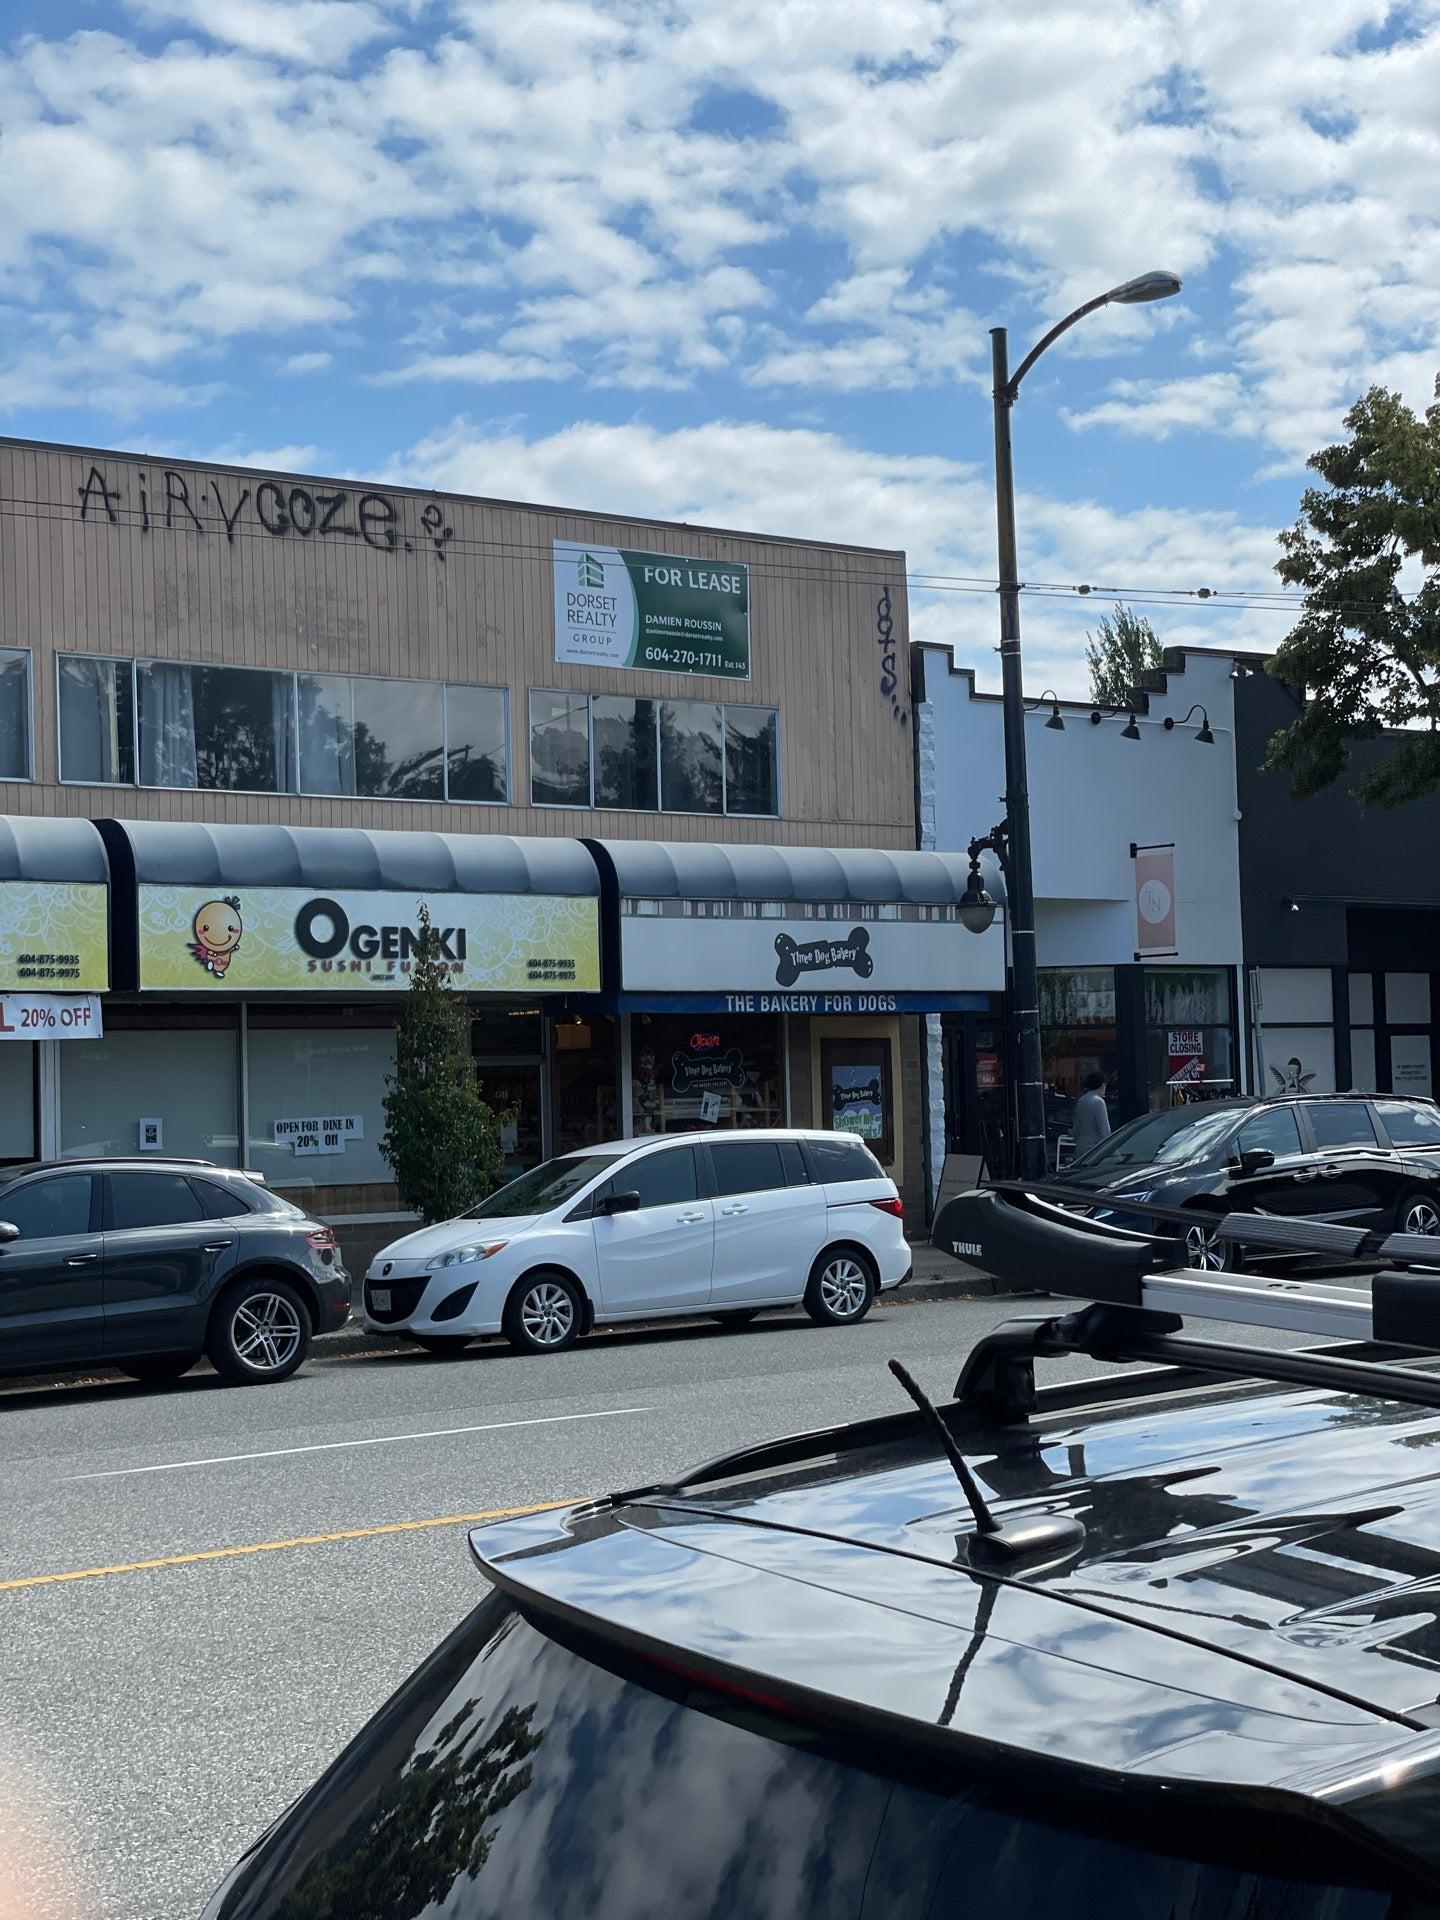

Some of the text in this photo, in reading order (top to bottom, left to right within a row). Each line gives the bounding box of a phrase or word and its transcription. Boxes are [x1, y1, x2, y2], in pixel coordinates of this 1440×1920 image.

[644, 566, 741, 594] FOR LEASE
[566, 592, 618, 611] DORSET
[567, 609, 618, 628] REALTY
[645, 614, 722, 631] DAMIEN ROUSSIN
[573, 633, 613, 646] GROUP
[645, 646, 722, 667] 604-270-1711
[18, 953, 80, 965] 604-875-9935
[791, 947, 857, 966] Three Dog Bakery
[18, 967, 80, 978] 604-875-9975
[307, 959, 464, 974] SUSHI FUON
[726, 995, 897, 1012] THE BAKERY FOR DOGS
[21, 1008, 56, 1028] 20%
[61, 1007, 91, 1027] OFF
[690, 1034, 721, 1051] Open
[1172, 1032, 1199, 1042] STORE
[1169, 1042, 1202, 1053] CLOSING
[276, 1118, 355, 1134] OPEN FOR DINE IN
[297, 1134, 319, 1148] 20%
[952, 1241, 982, 1256] THULE
